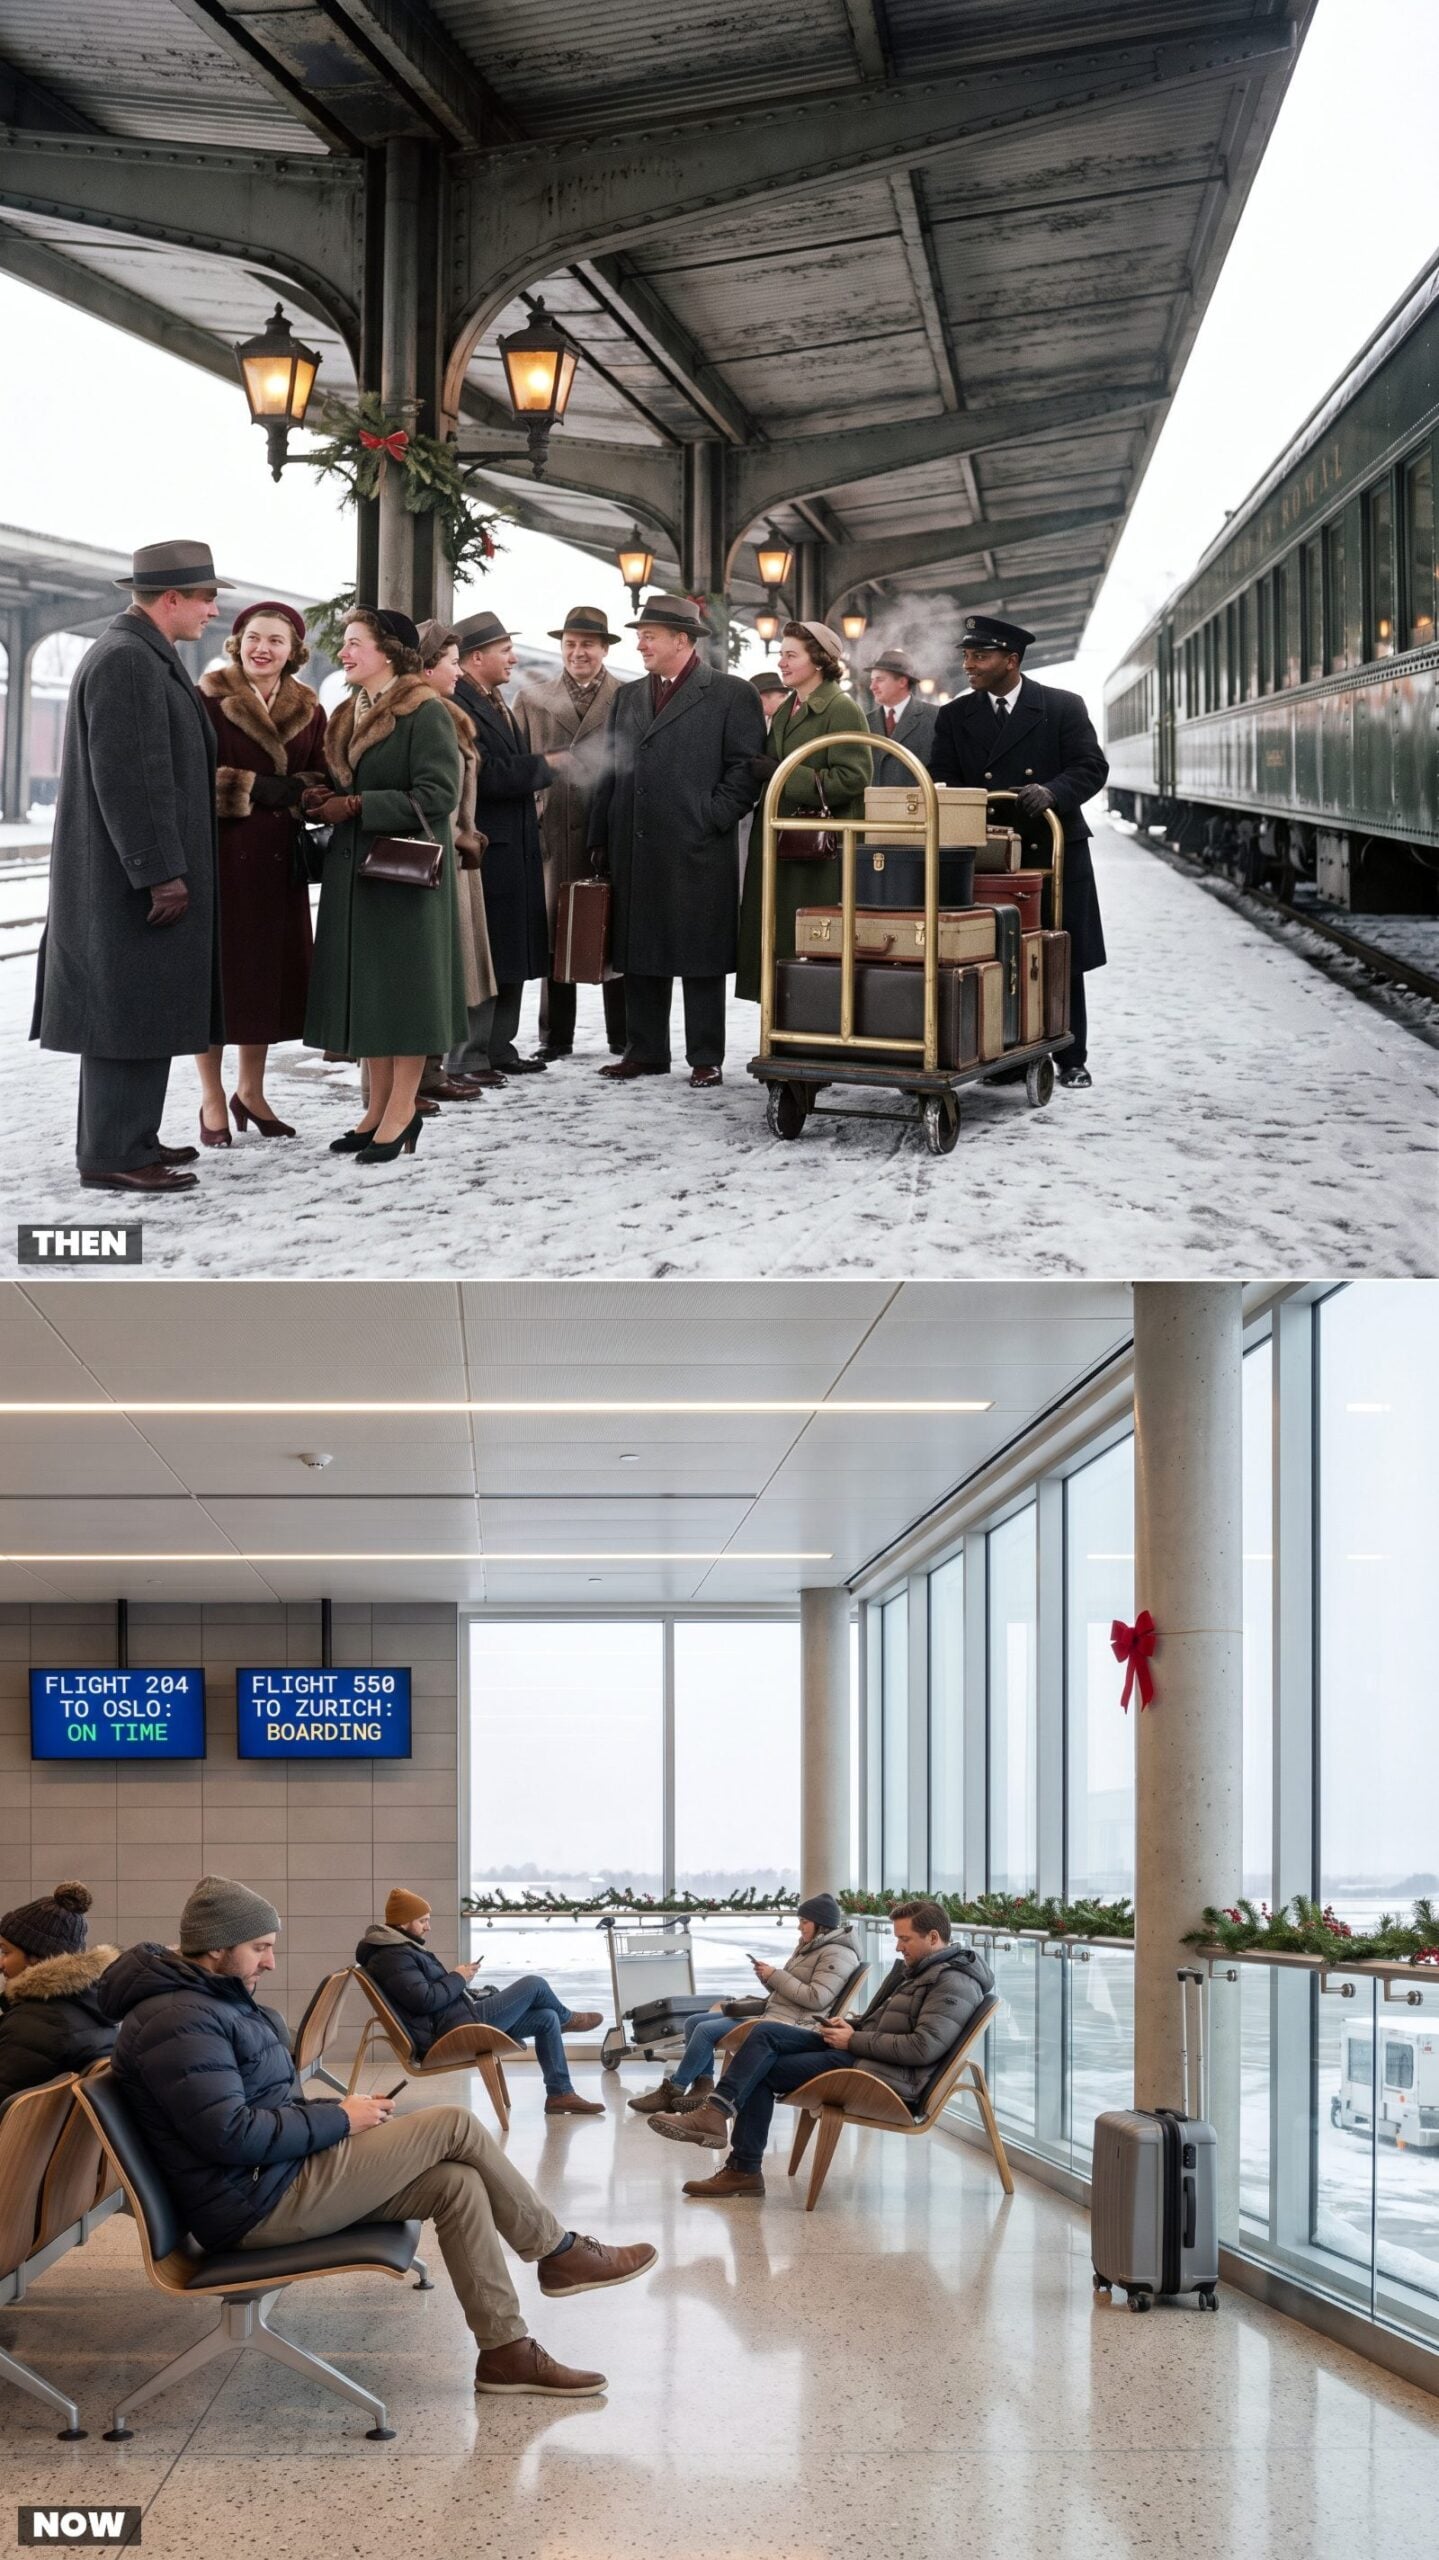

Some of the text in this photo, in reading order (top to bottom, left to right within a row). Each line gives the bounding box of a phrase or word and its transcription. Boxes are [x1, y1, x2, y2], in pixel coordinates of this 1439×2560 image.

[45, 1676, 189, 1694] FLIGHT 204
[252, 1675, 395, 1694] FLIGHT 550
[60, 1700, 172, 1718] TO OSLO:
[252, 1699, 392, 1717] TO ZURICH:
[67, 1723, 168, 1742] ON TIME
[267, 1722, 382, 1741] BOARDING
